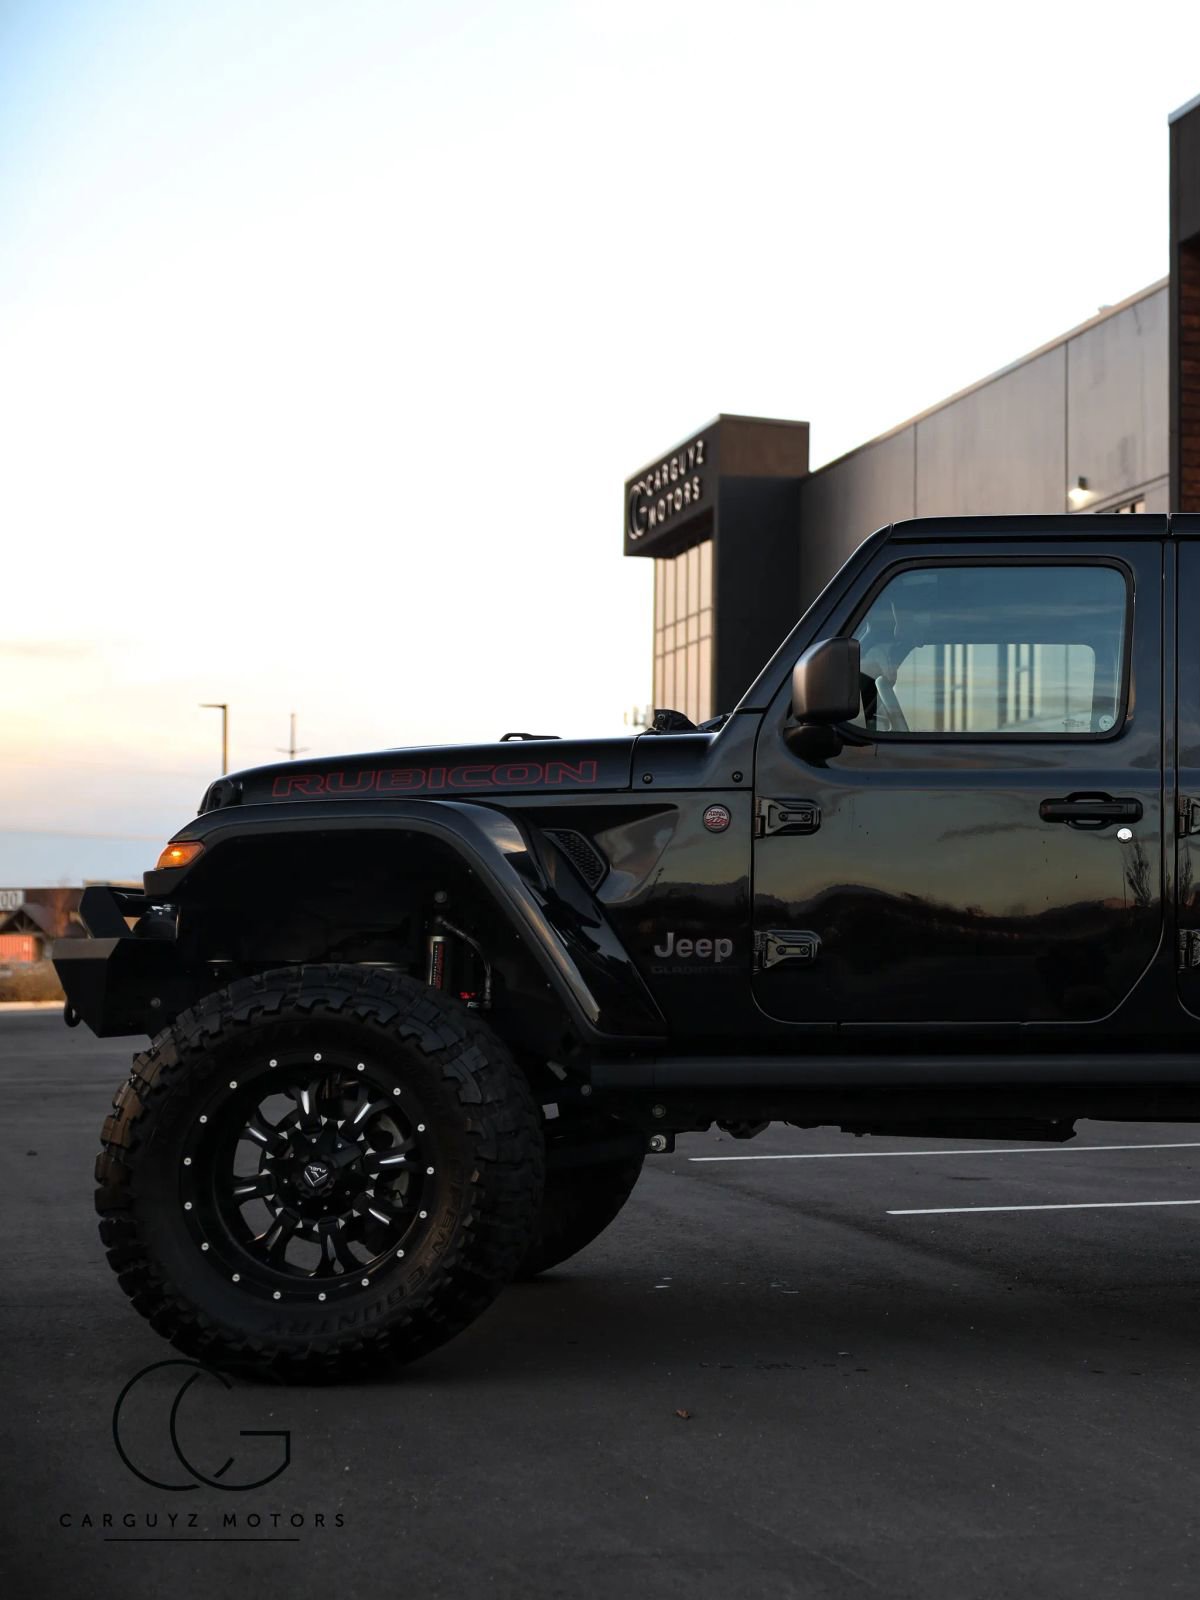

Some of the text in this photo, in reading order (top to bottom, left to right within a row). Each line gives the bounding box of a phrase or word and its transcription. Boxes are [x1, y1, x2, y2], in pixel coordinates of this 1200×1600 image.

[645, 440, 704, 496] CARGUYZ
[648, 475, 700, 529] MOTORS
[272, 760, 597, 797] RUBICON
[654, 932, 733, 963] Jeep
